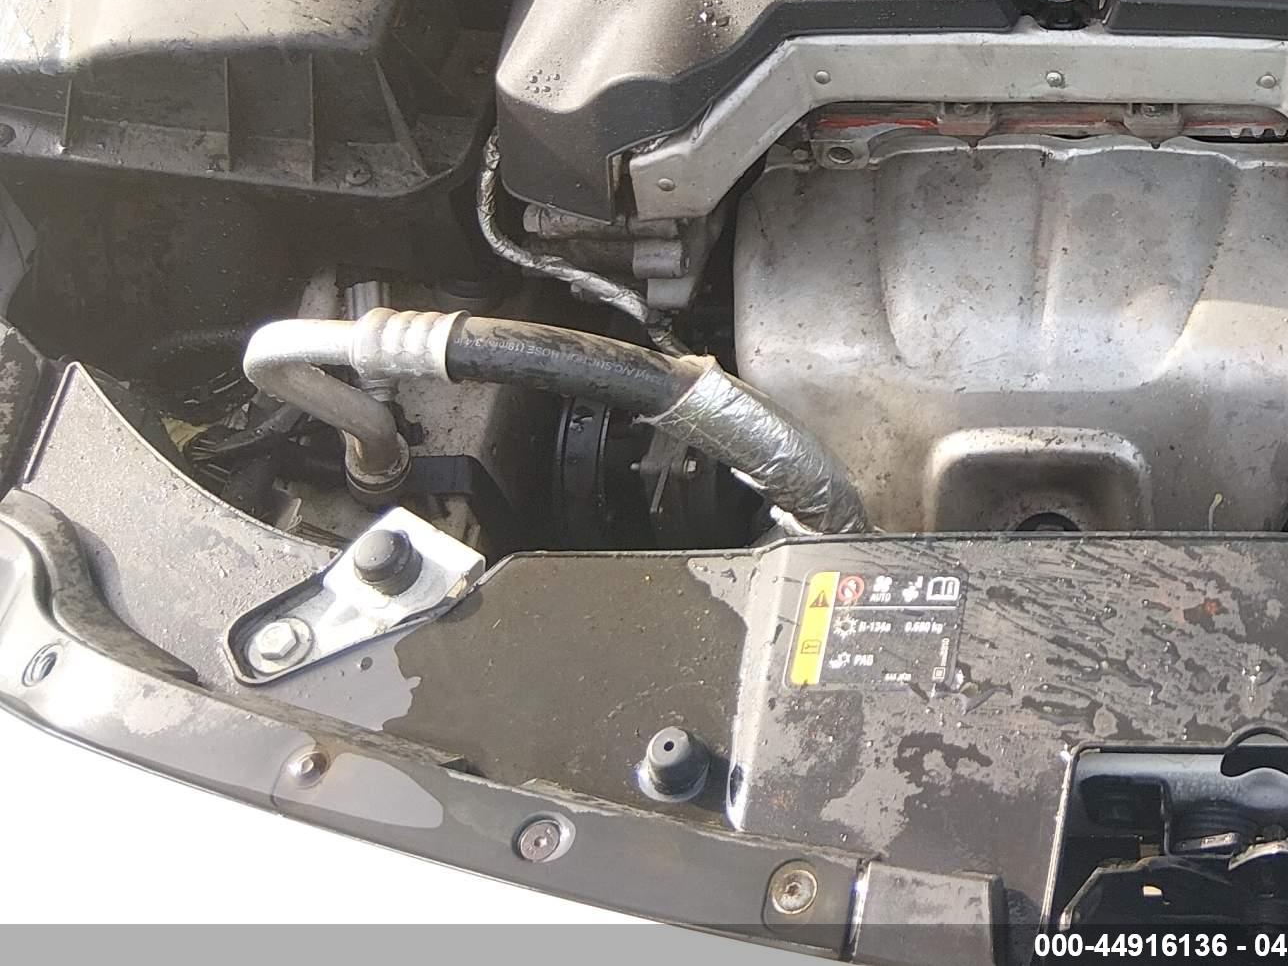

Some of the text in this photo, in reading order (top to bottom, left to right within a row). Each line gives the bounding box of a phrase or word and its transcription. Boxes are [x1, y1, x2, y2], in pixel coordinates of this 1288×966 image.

[526, 345, 559, 360] HOSE
[615, 362, 633, 377] A/C
[869, 592, 892, 603] AUTO
